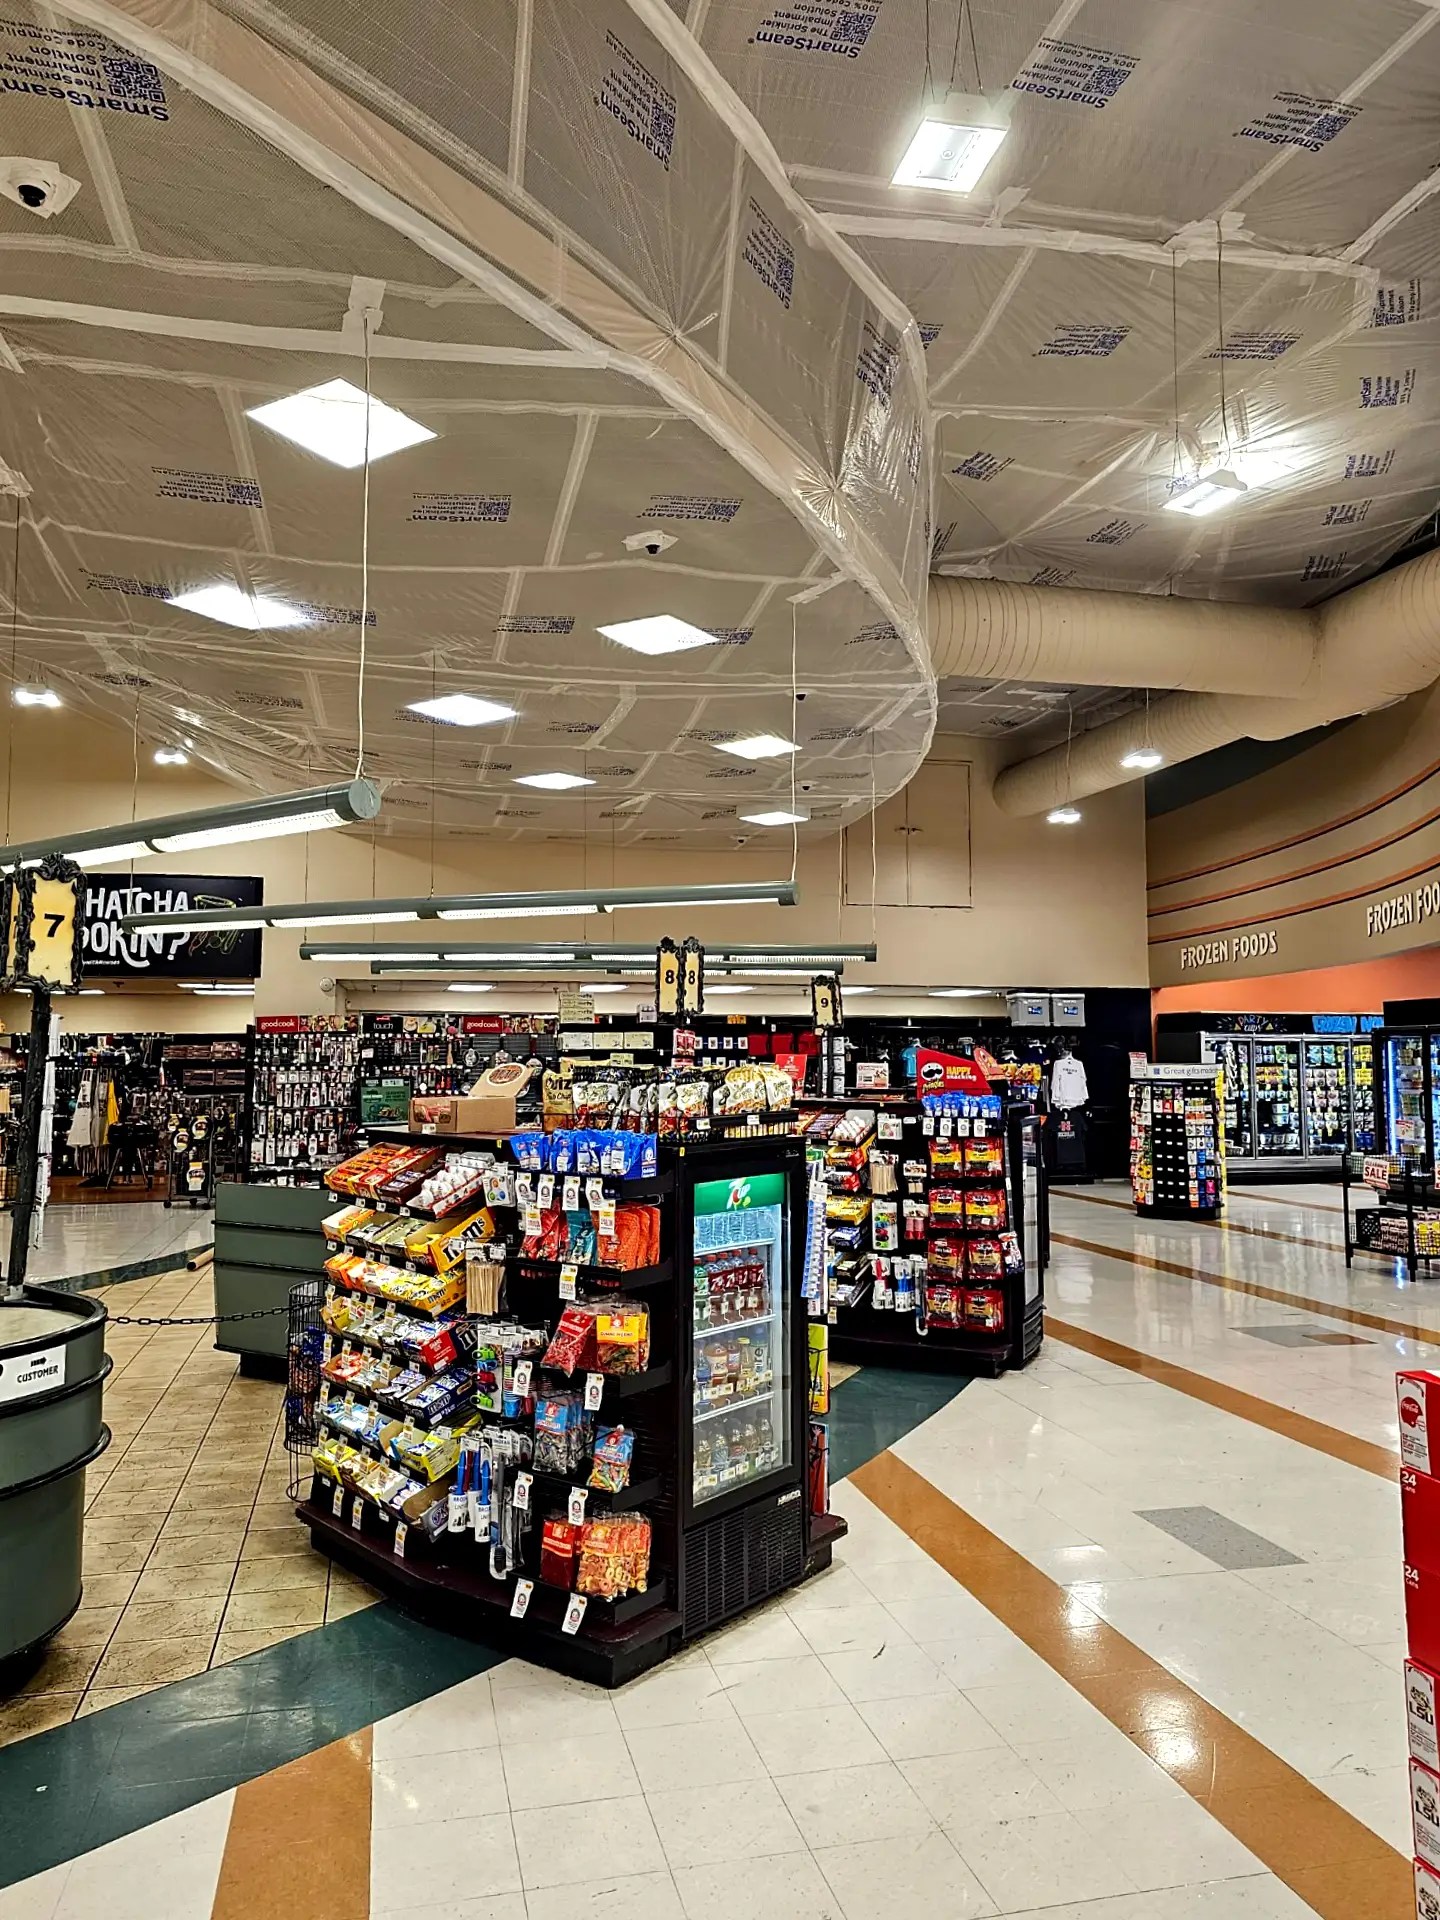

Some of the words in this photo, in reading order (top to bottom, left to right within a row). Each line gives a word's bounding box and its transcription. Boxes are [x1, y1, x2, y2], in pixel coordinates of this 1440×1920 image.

[794, 3, 838, 17] Solution
[855, 2, 879, 13] 100%
[761, 19, 808, 33] Sprinkler
[774, 10, 834, 27] Impairment
[811, 27, 828, 37] The
[67, 39, 106, 51] Code
[29, 45, 97, 66] Solution
[1087, 53, 1110, 63] Code
[6, 53, 101, 78] Impairment
[1032, 62, 1090, 79] Impairment
[1054, 57, 1095, 72] Solution
[1113, 59, 1136, 69] 100%
[1064, 79, 1081, 88] The
[86, 888, 189, 919] HATCHA
[1367, 893, 1413, 937] FROZEN
[1416, 881, 1440, 923] FOO
[44, 913, 65, 938] 7
[82, 922, 190, 968] OKIN?
[1181, 938, 1229, 970] FROZEN
[1232, 930, 1278, 962] FOODS
[665, 970, 674, 984] 8
[688, 970, 695, 984] 8
[820, 997, 829, 1008] 9
[374, 1022, 393, 1030] touch
[946, 1066, 971, 1074] HAPPY
[1163, 1066, 1185, 1074] Great
[1365, 1166, 1387, 1180] SALE
[17, 1365, 58, 1383] CUSTOMER
[1402, 1470, 1416, 1487] 24
[1405, 1565, 1419, 1582] 24
[1409, 1701, 1434, 1725] LSU
[1415, 1800, 1439, 1827] LSU
[1418, 1902, 1440, 1920] LS
